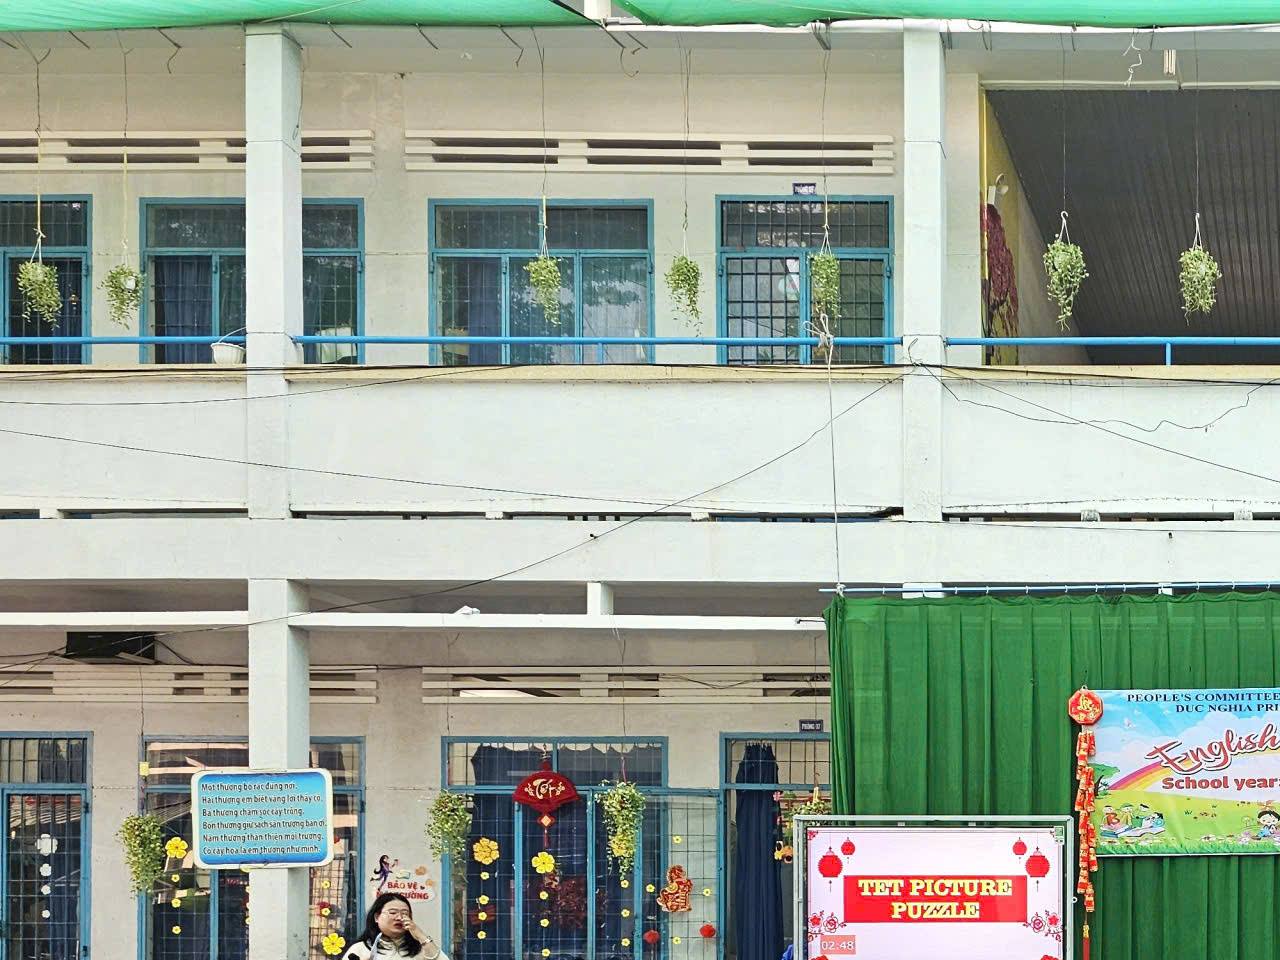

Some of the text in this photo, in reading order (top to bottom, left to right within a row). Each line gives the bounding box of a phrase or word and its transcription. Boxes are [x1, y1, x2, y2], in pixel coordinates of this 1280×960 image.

[1127, 693, 1192, 702] PEOPLE'S
[1195, 692, 1280, 701] COMMITTEE
[1176, 704, 1204, 713] DUC
[1208, 704, 1252, 712] NGHIA
[1162, 776, 1230, 789] School
[858, 879, 1012, 896] TET PICTURE
[891, 902, 980, 919] PUZZLE
[821, 940, 855, 951] 02:48
